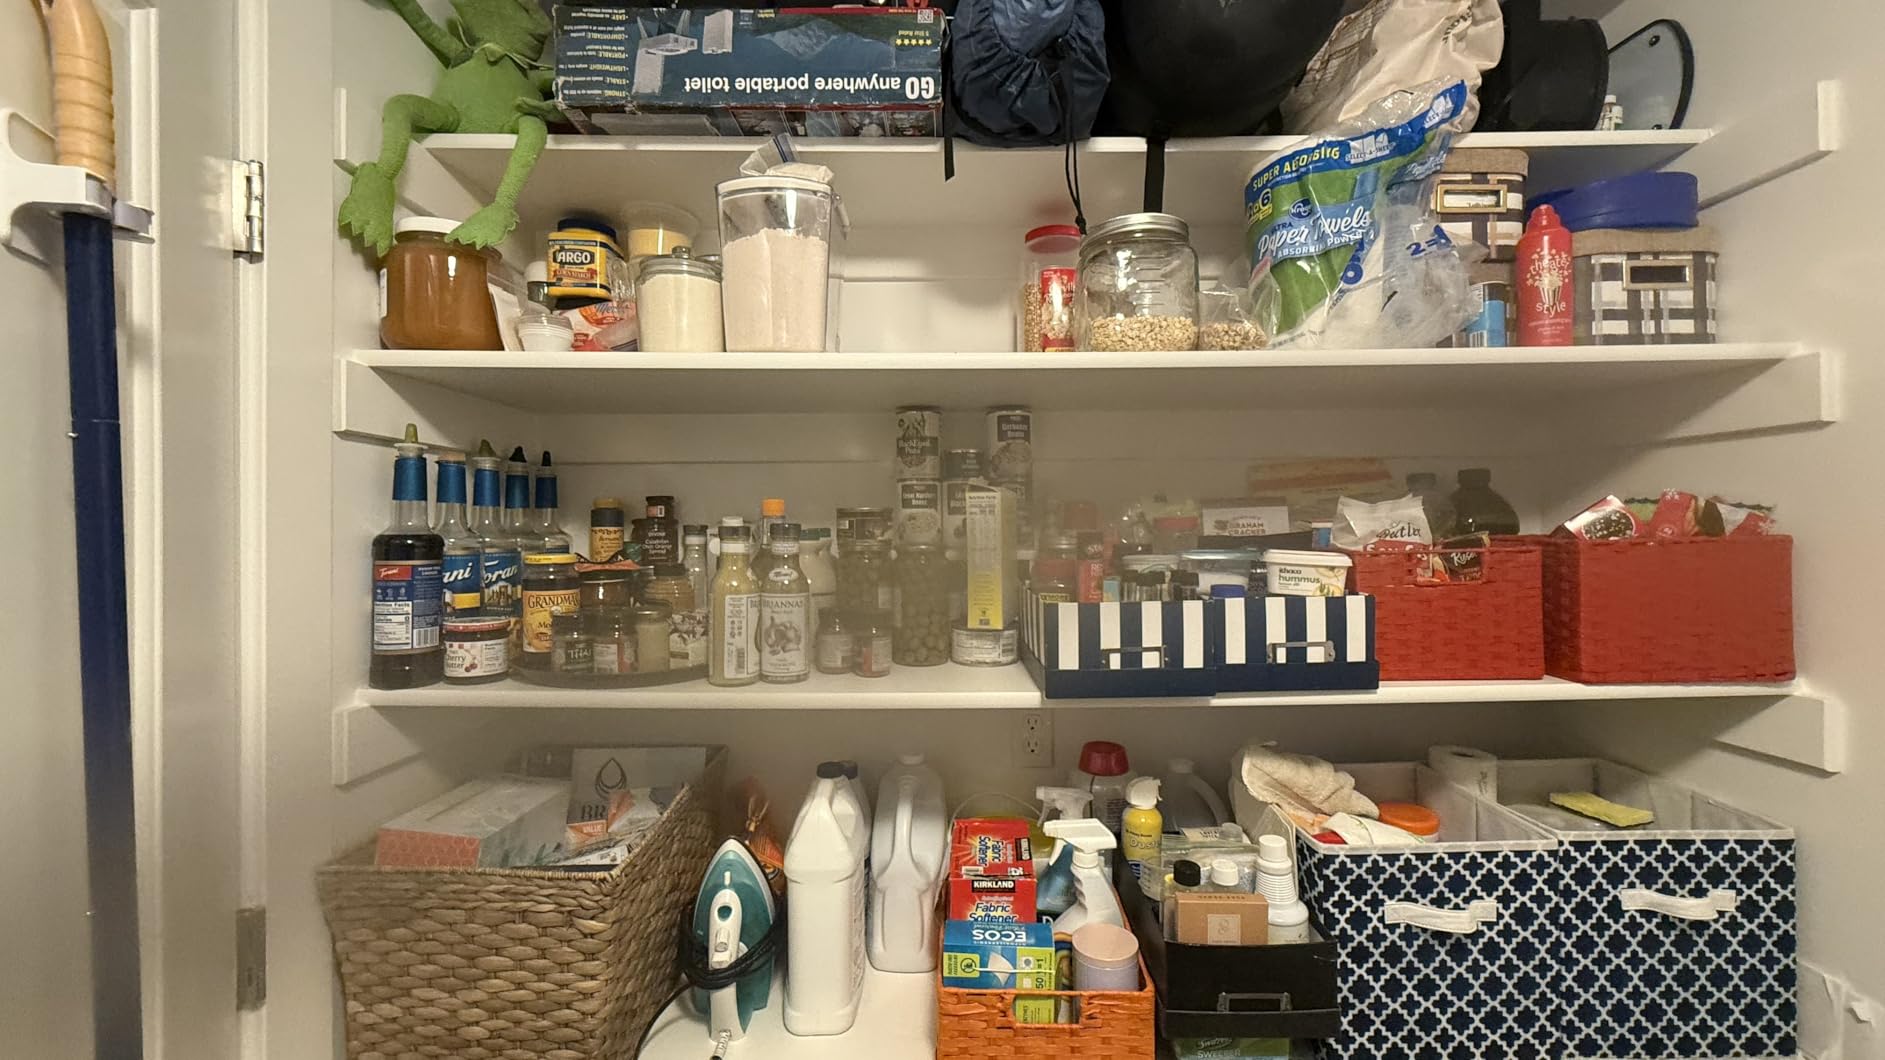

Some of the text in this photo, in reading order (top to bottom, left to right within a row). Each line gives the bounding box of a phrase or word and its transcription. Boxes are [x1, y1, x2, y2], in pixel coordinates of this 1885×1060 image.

[684, 74, 936, 100] GO anywhere portable toilet
[1253, 165, 1280, 191] SUPER
[1258, 224, 1309, 258] Paper
[1310, 205, 1372, 241] Twels
[556, 250, 591, 264] ARGO
[1530, 256, 1570, 275] theater
[1536, 301, 1567, 318] style
[1278, 574, 1321, 585] hummus
[973, 880, 1015, 889] KIRKLAND
[975, 902, 1011, 913] Fabric
[968, 912, 1018, 923] Softener
[972, 929, 1027, 942] ECOS
